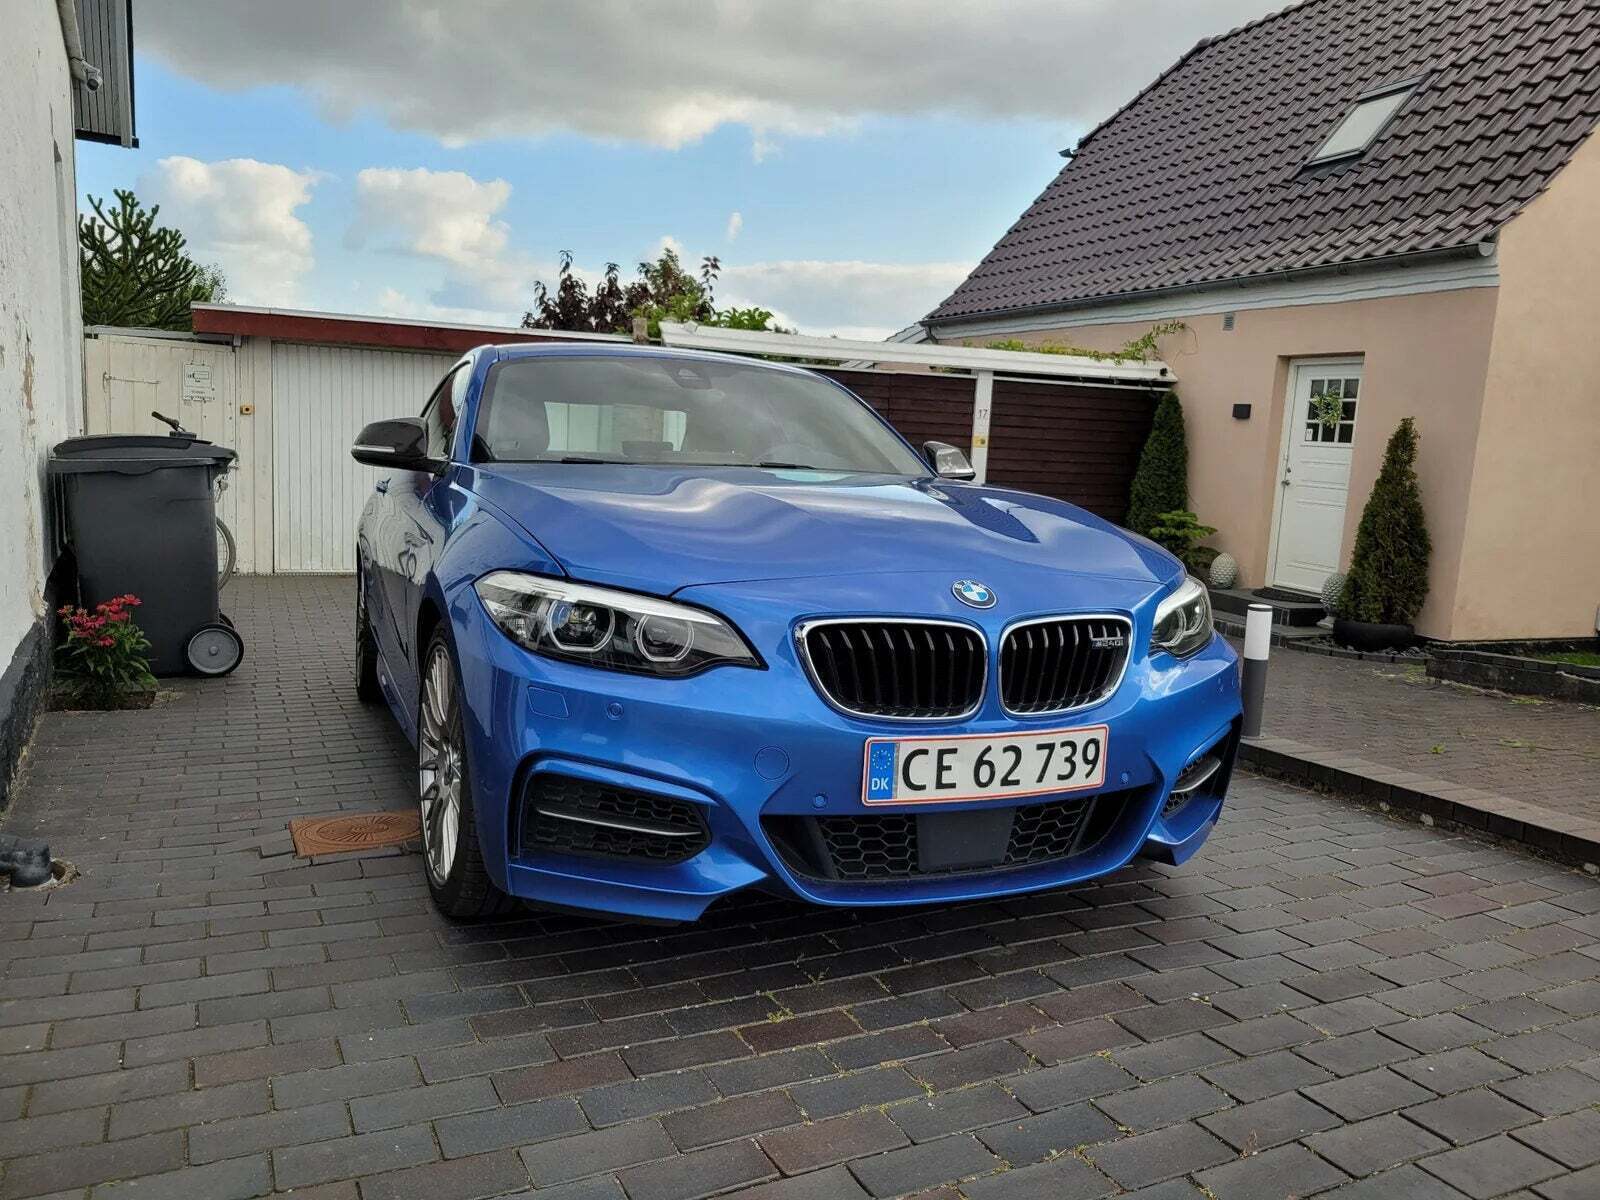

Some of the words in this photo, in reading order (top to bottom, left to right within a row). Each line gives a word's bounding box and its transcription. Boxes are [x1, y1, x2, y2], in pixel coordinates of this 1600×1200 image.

[902, 748, 959, 791] CE
[973, 745, 1022, 788] 62
[1036, 737, 1101, 783] 739
[871, 777, 889, 790] DK
